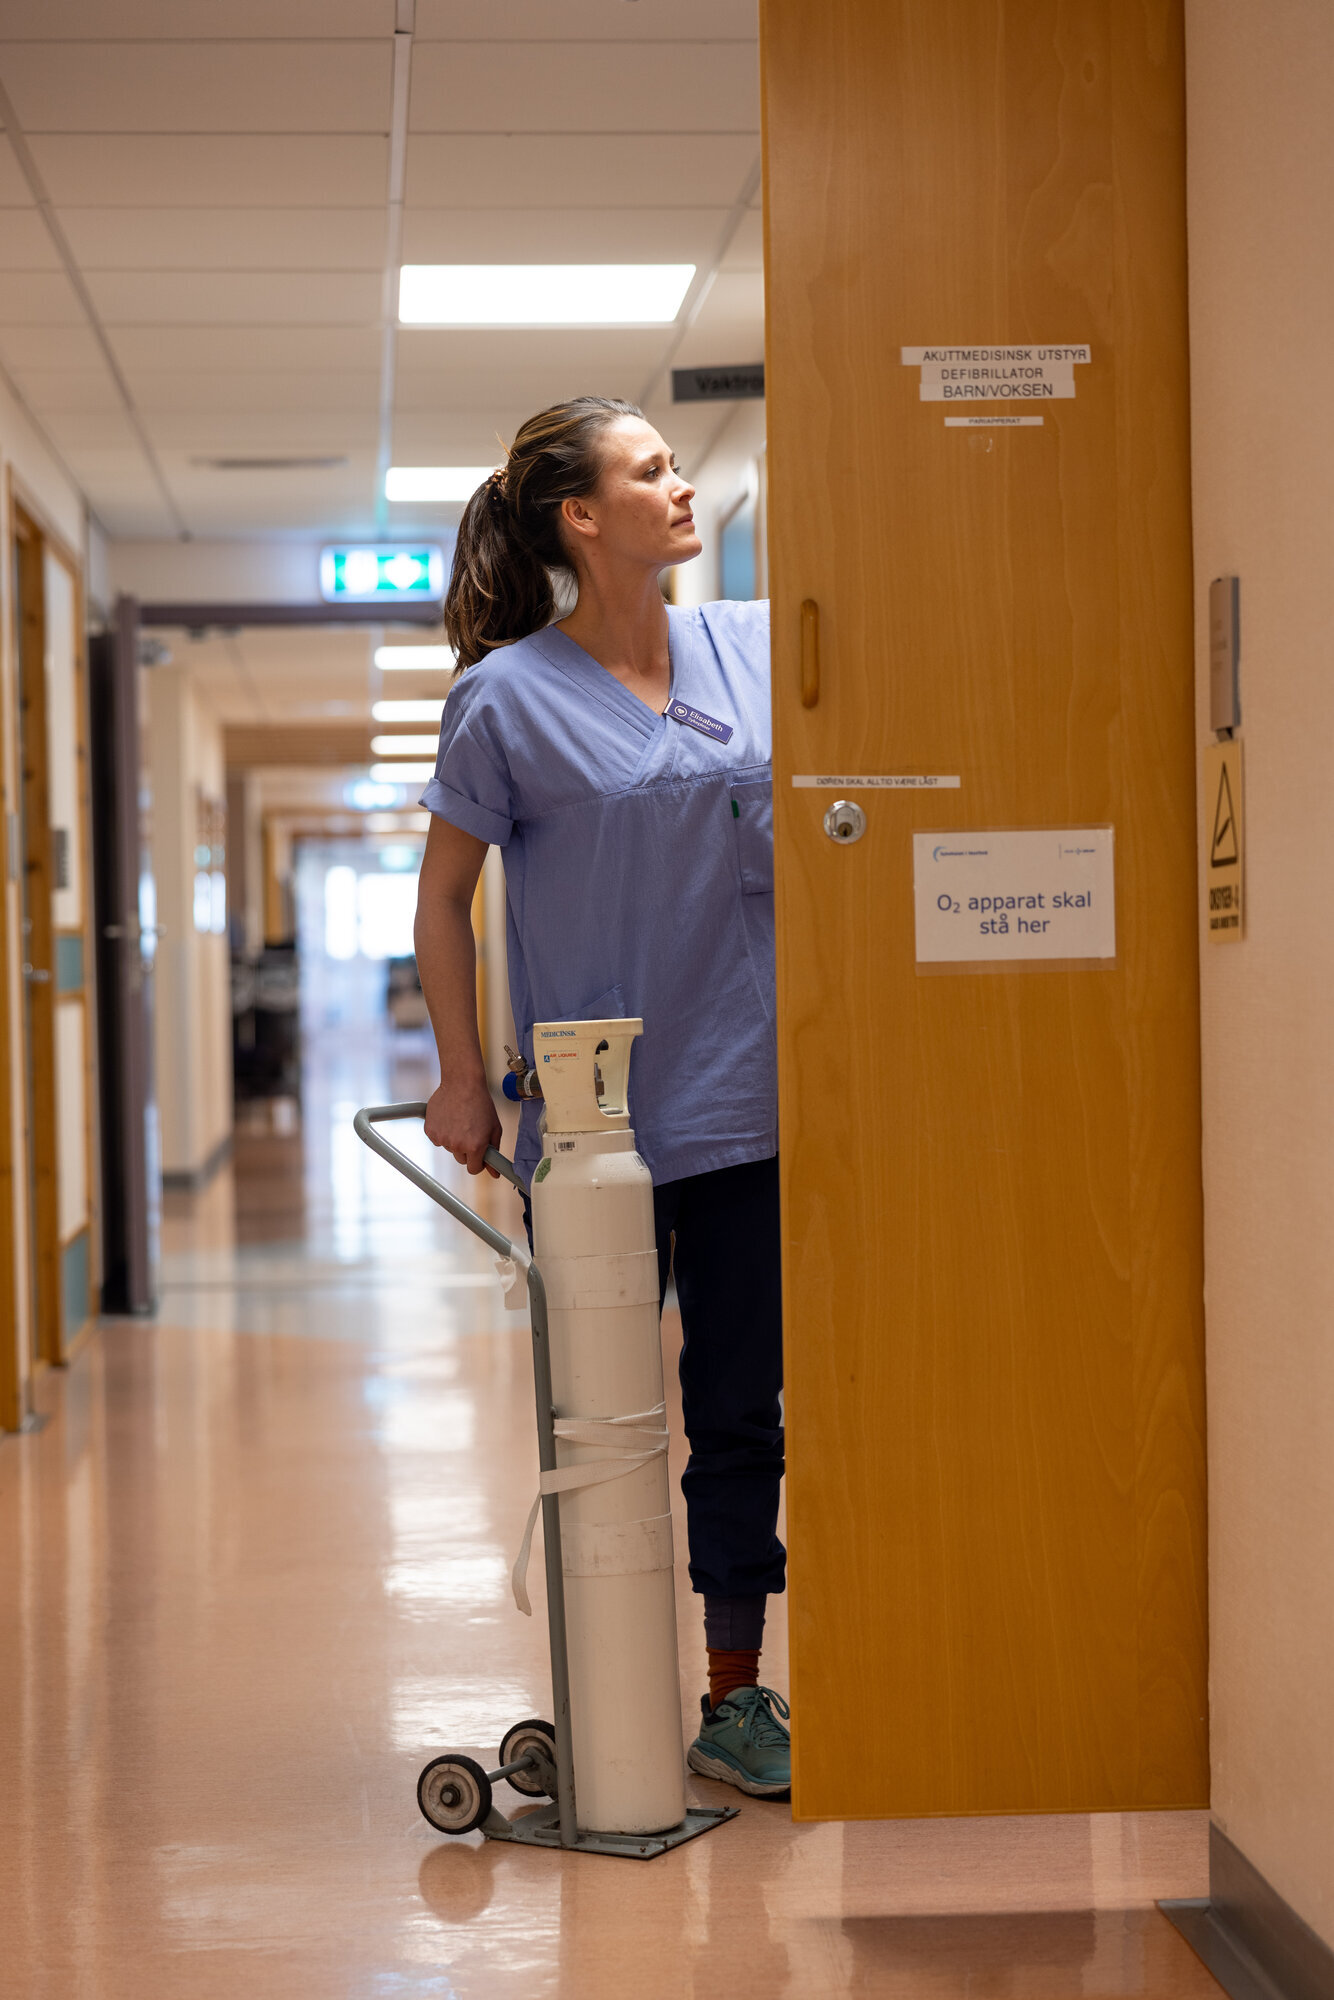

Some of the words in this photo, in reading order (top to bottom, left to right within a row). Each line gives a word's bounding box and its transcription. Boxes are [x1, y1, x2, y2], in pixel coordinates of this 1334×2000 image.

[922, 349, 1033, 362] AKUTTMEDISINSK
[1037, 349, 1088, 361] UTSTYR
[941, 368, 1044, 380] DEFIBRILLATOR
[943, 383, 1054, 399] BARN/VOKSEN
[689, 710, 724, 732] Elisabeth
[816, 777, 844, 786] DØREN
[845, 777, 865, 786] SKAL
[866, 777, 893, 786] ALLTID
[894, 777, 917, 786] VÆRE
[918, 776, 938, 786] LÅST
[967, 893, 1046, 913] apparat
[1052, 890, 1092, 909] skal
[979, 912, 1010, 935] stå
[1017, 916, 1051, 934] her
[540, 1030, 577, 1038] MEDICINSK
